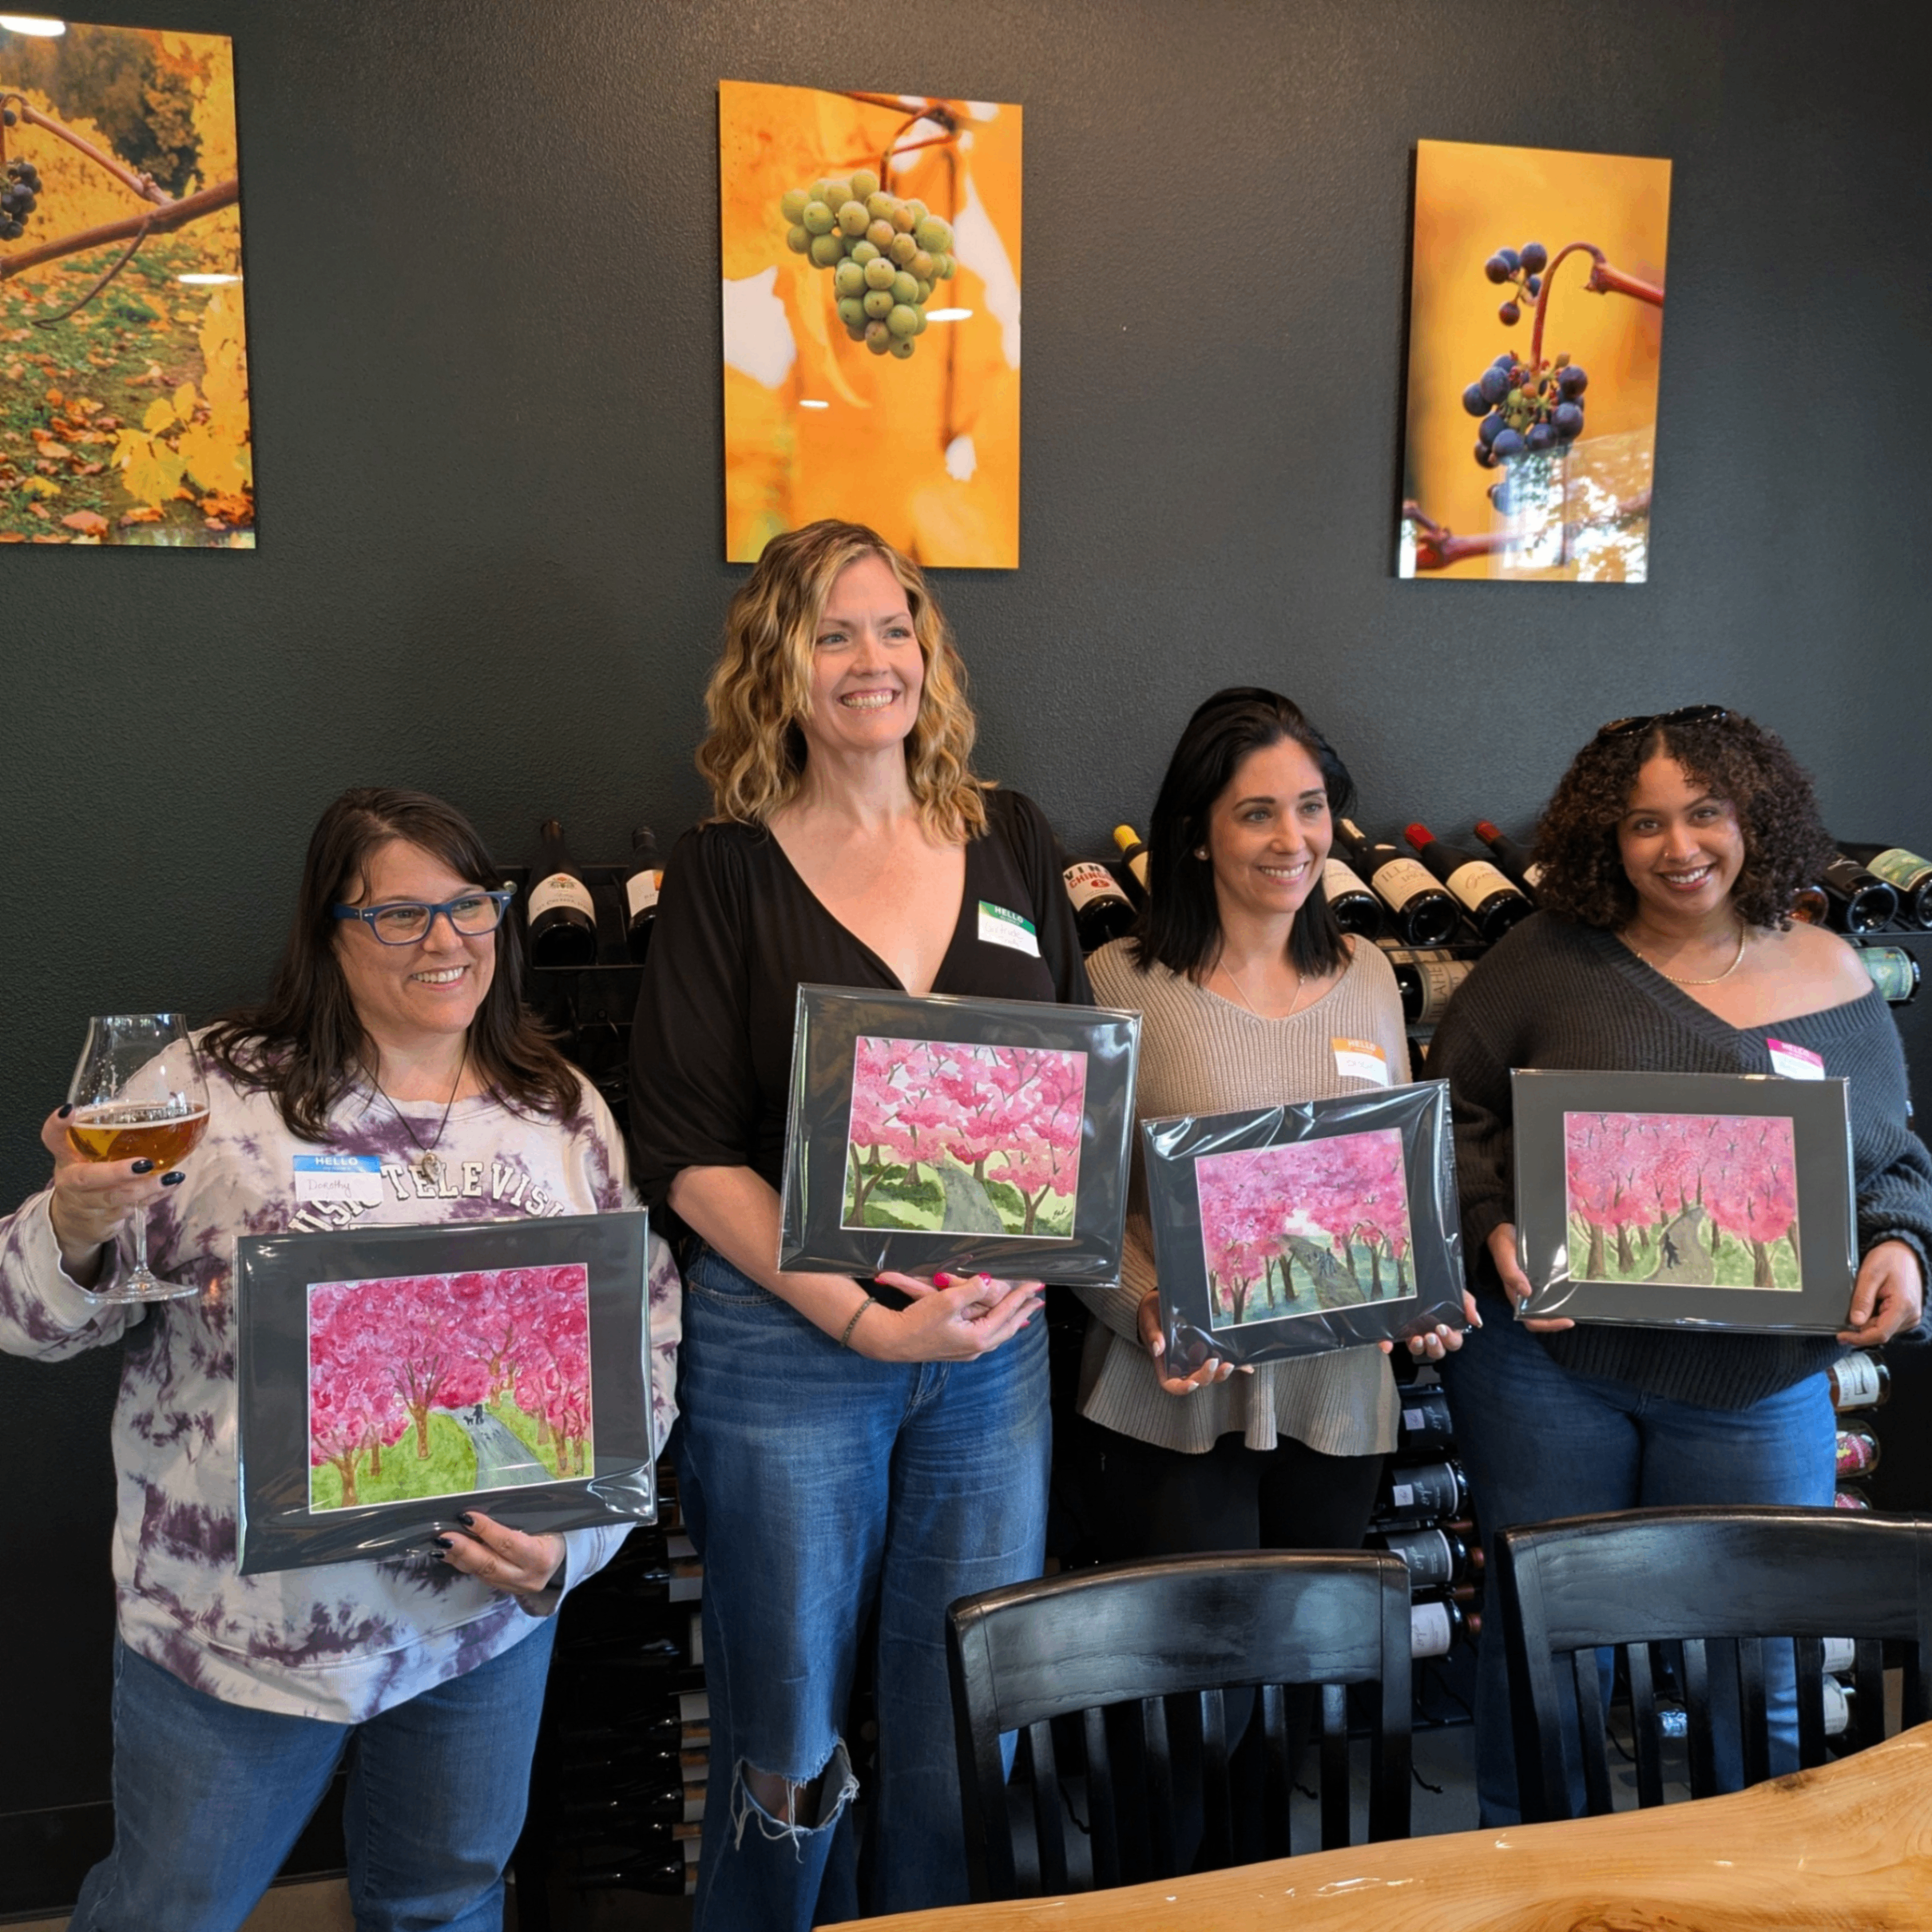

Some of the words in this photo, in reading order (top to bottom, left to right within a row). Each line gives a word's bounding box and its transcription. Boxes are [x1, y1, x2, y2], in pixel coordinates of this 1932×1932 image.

[1064, 865, 1110, 881] VIN
[994, 906, 1025, 923] HELLO
[315, 1157, 359, 1166] HELLO
